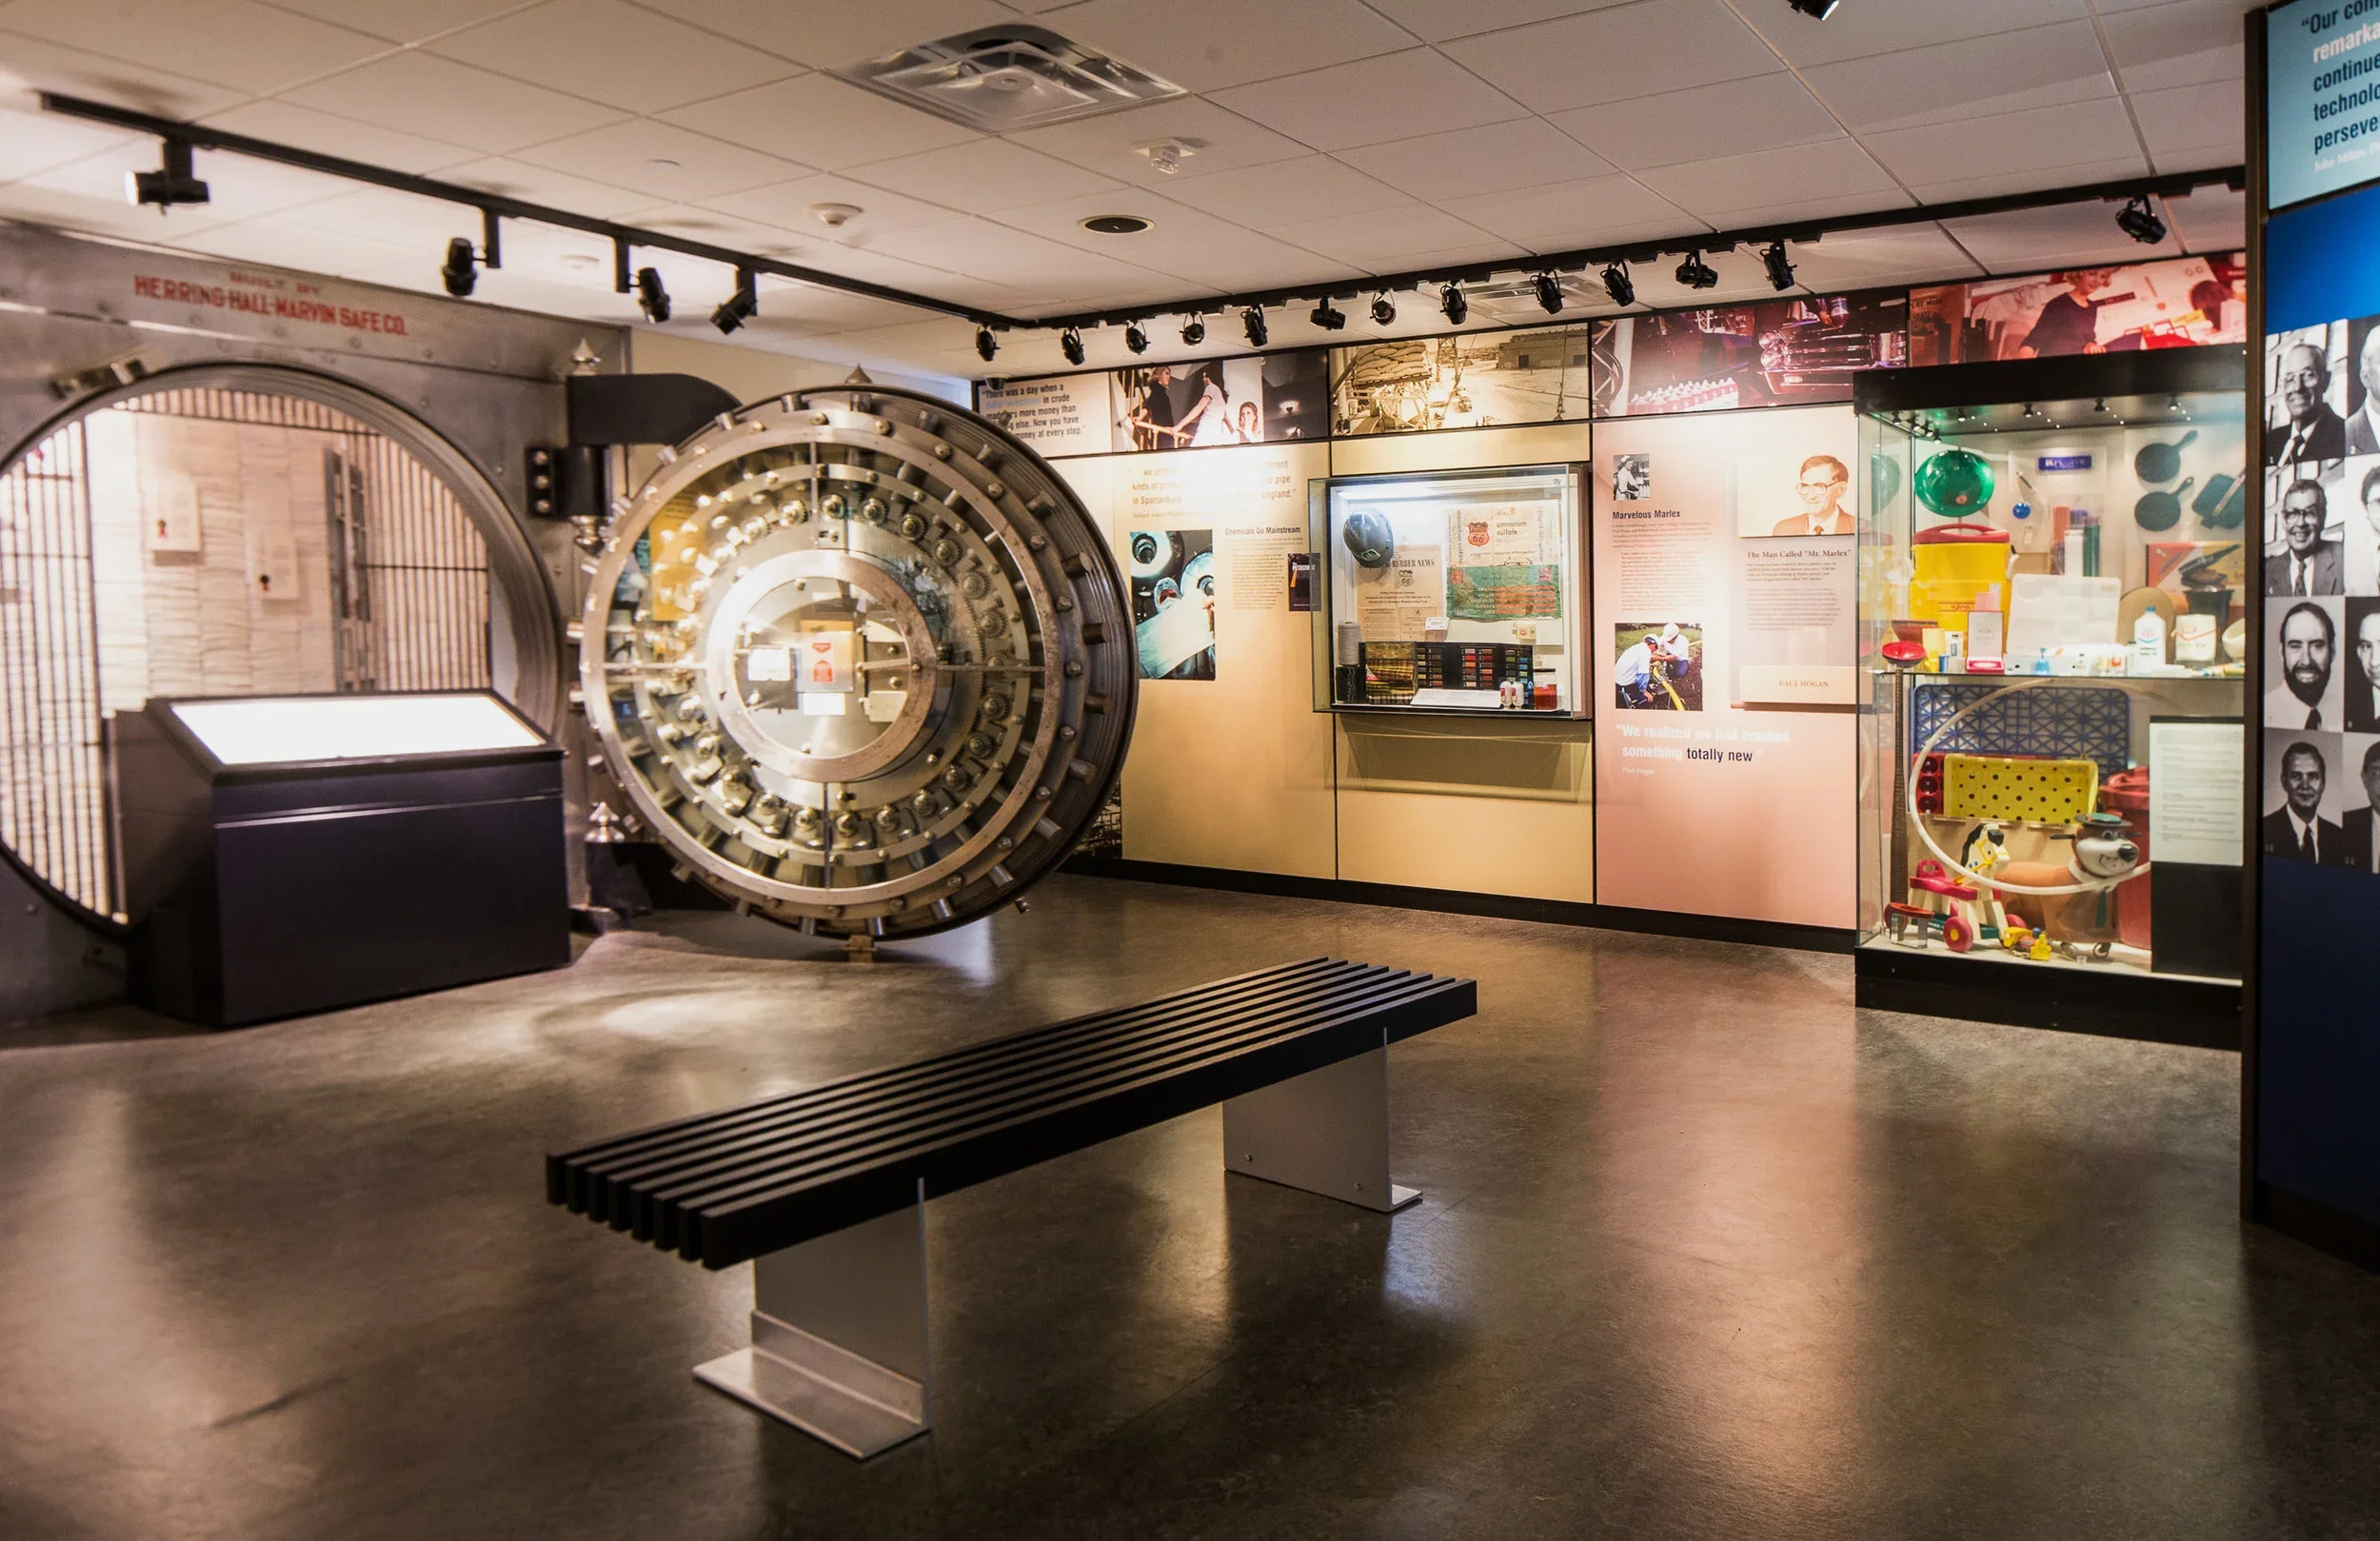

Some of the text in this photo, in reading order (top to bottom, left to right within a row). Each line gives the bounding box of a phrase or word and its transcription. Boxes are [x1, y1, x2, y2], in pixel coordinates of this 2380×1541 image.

[2302, 10, 2338, 34] “Our
[2314, 114, 2380, 155] perseve
[340, 306, 381, 332] SAFE
[1005, 388, 1019, 397] was
[1026, 386, 1039, 395] day
[1040, 384, 1058, 392] when
[1051, 393, 1070, 403] crude
[1019, 408, 1036, 417] more
[1038, 407, 1060, 416] money
[1061, 405, 1077, 413] than
[1033, 419, 1047, 427] Now
[1049, 418, 1061, 426] you
[1063, 415, 1080, 425] have
[1046, 428, 1064, 437] every
[1612, 509, 1681, 520] Marvelous Marlex
[1265, 526, 1301, 535] Mainstream
[1418, 558, 1436, 567] NEWS
[1400, 577, 1411, 585] 66
[1622, 745, 1683, 761] something
[1687, 747, 1724, 762] totally
